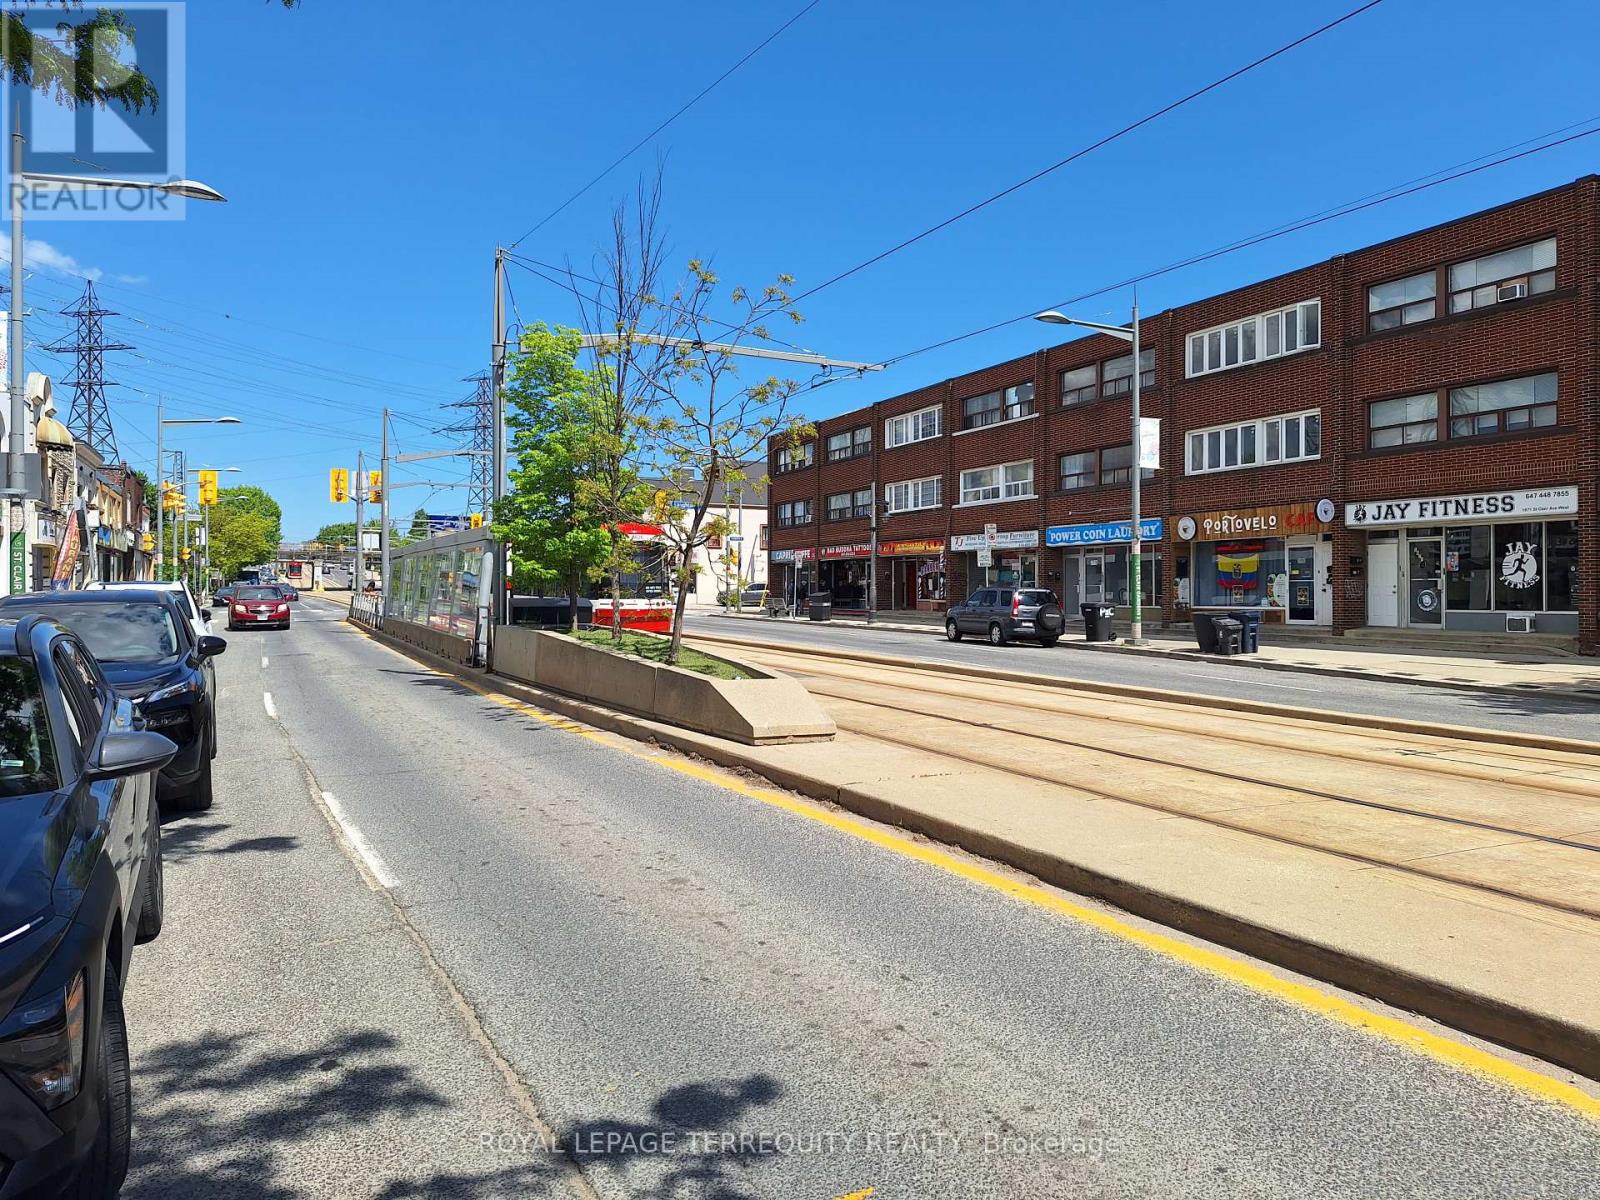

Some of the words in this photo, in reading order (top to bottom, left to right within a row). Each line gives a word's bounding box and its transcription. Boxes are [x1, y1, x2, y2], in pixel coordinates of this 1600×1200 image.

[1372, 503, 1411, 520] JAY
[1419, 495, 1514, 518] FITNESS
[1050, 531, 1081, 542] POWER
[1083, 529, 1106, 540] COIN
[1108, 525, 1157, 538] LAURY
[1505, 541, 1538, 556] JAY
[13, 565, 23, 590] CLAIR
[1499, 574, 1540, 589] FITNESS
